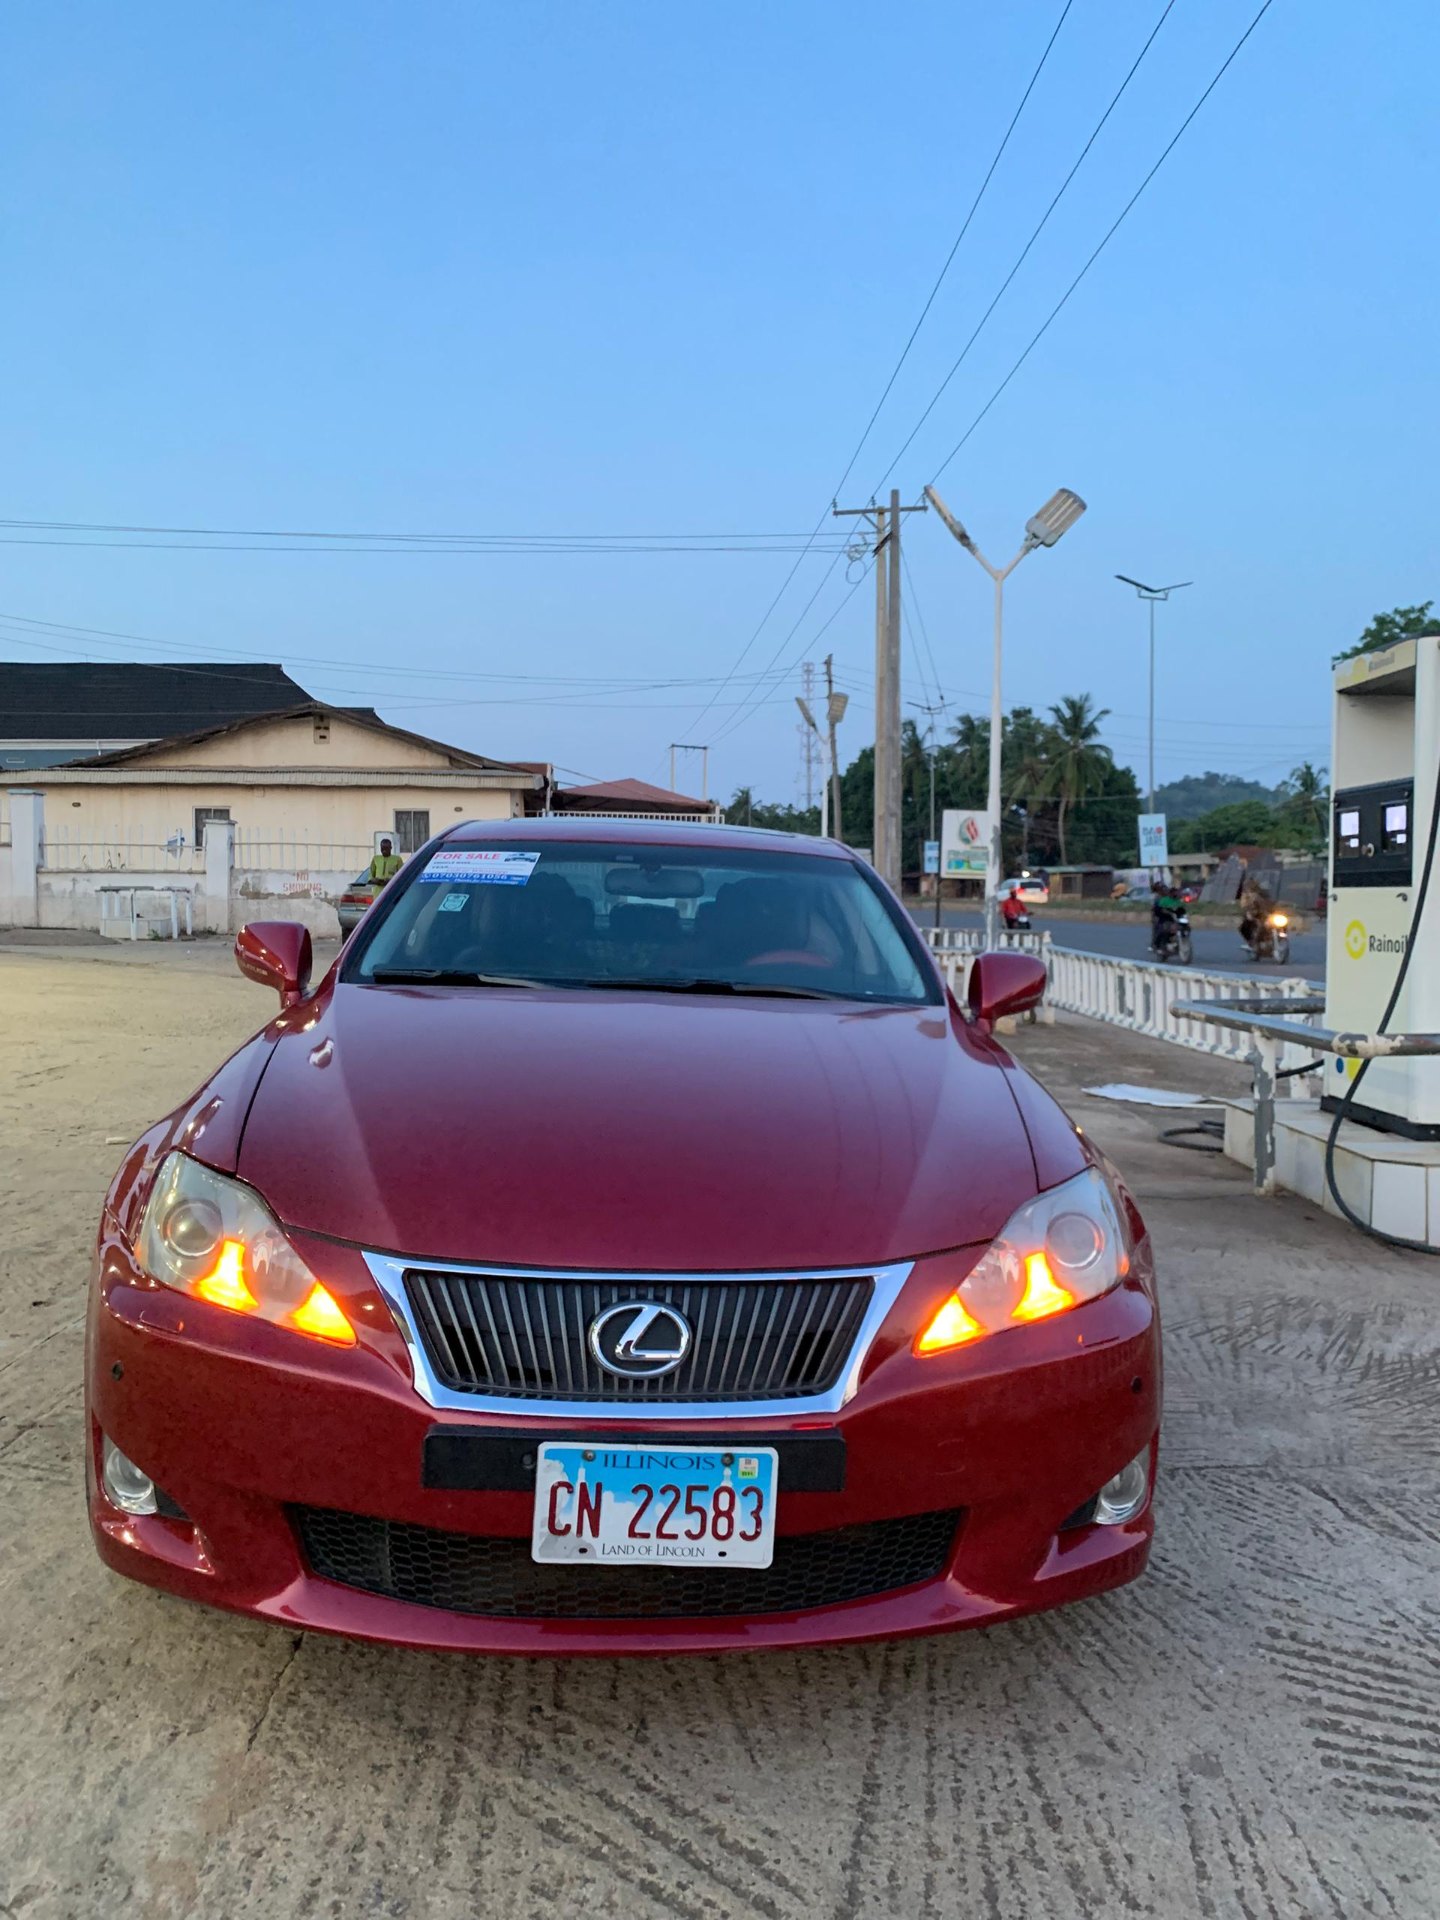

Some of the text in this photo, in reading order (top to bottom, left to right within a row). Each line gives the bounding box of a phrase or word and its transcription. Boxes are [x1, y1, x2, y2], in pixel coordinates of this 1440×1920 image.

[604, 1453, 716, 1470] ILLINOIS
[547, 1480, 764, 1542] CN 22583
[601, 1543, 705, 1557] LAND OF LINCOLN
